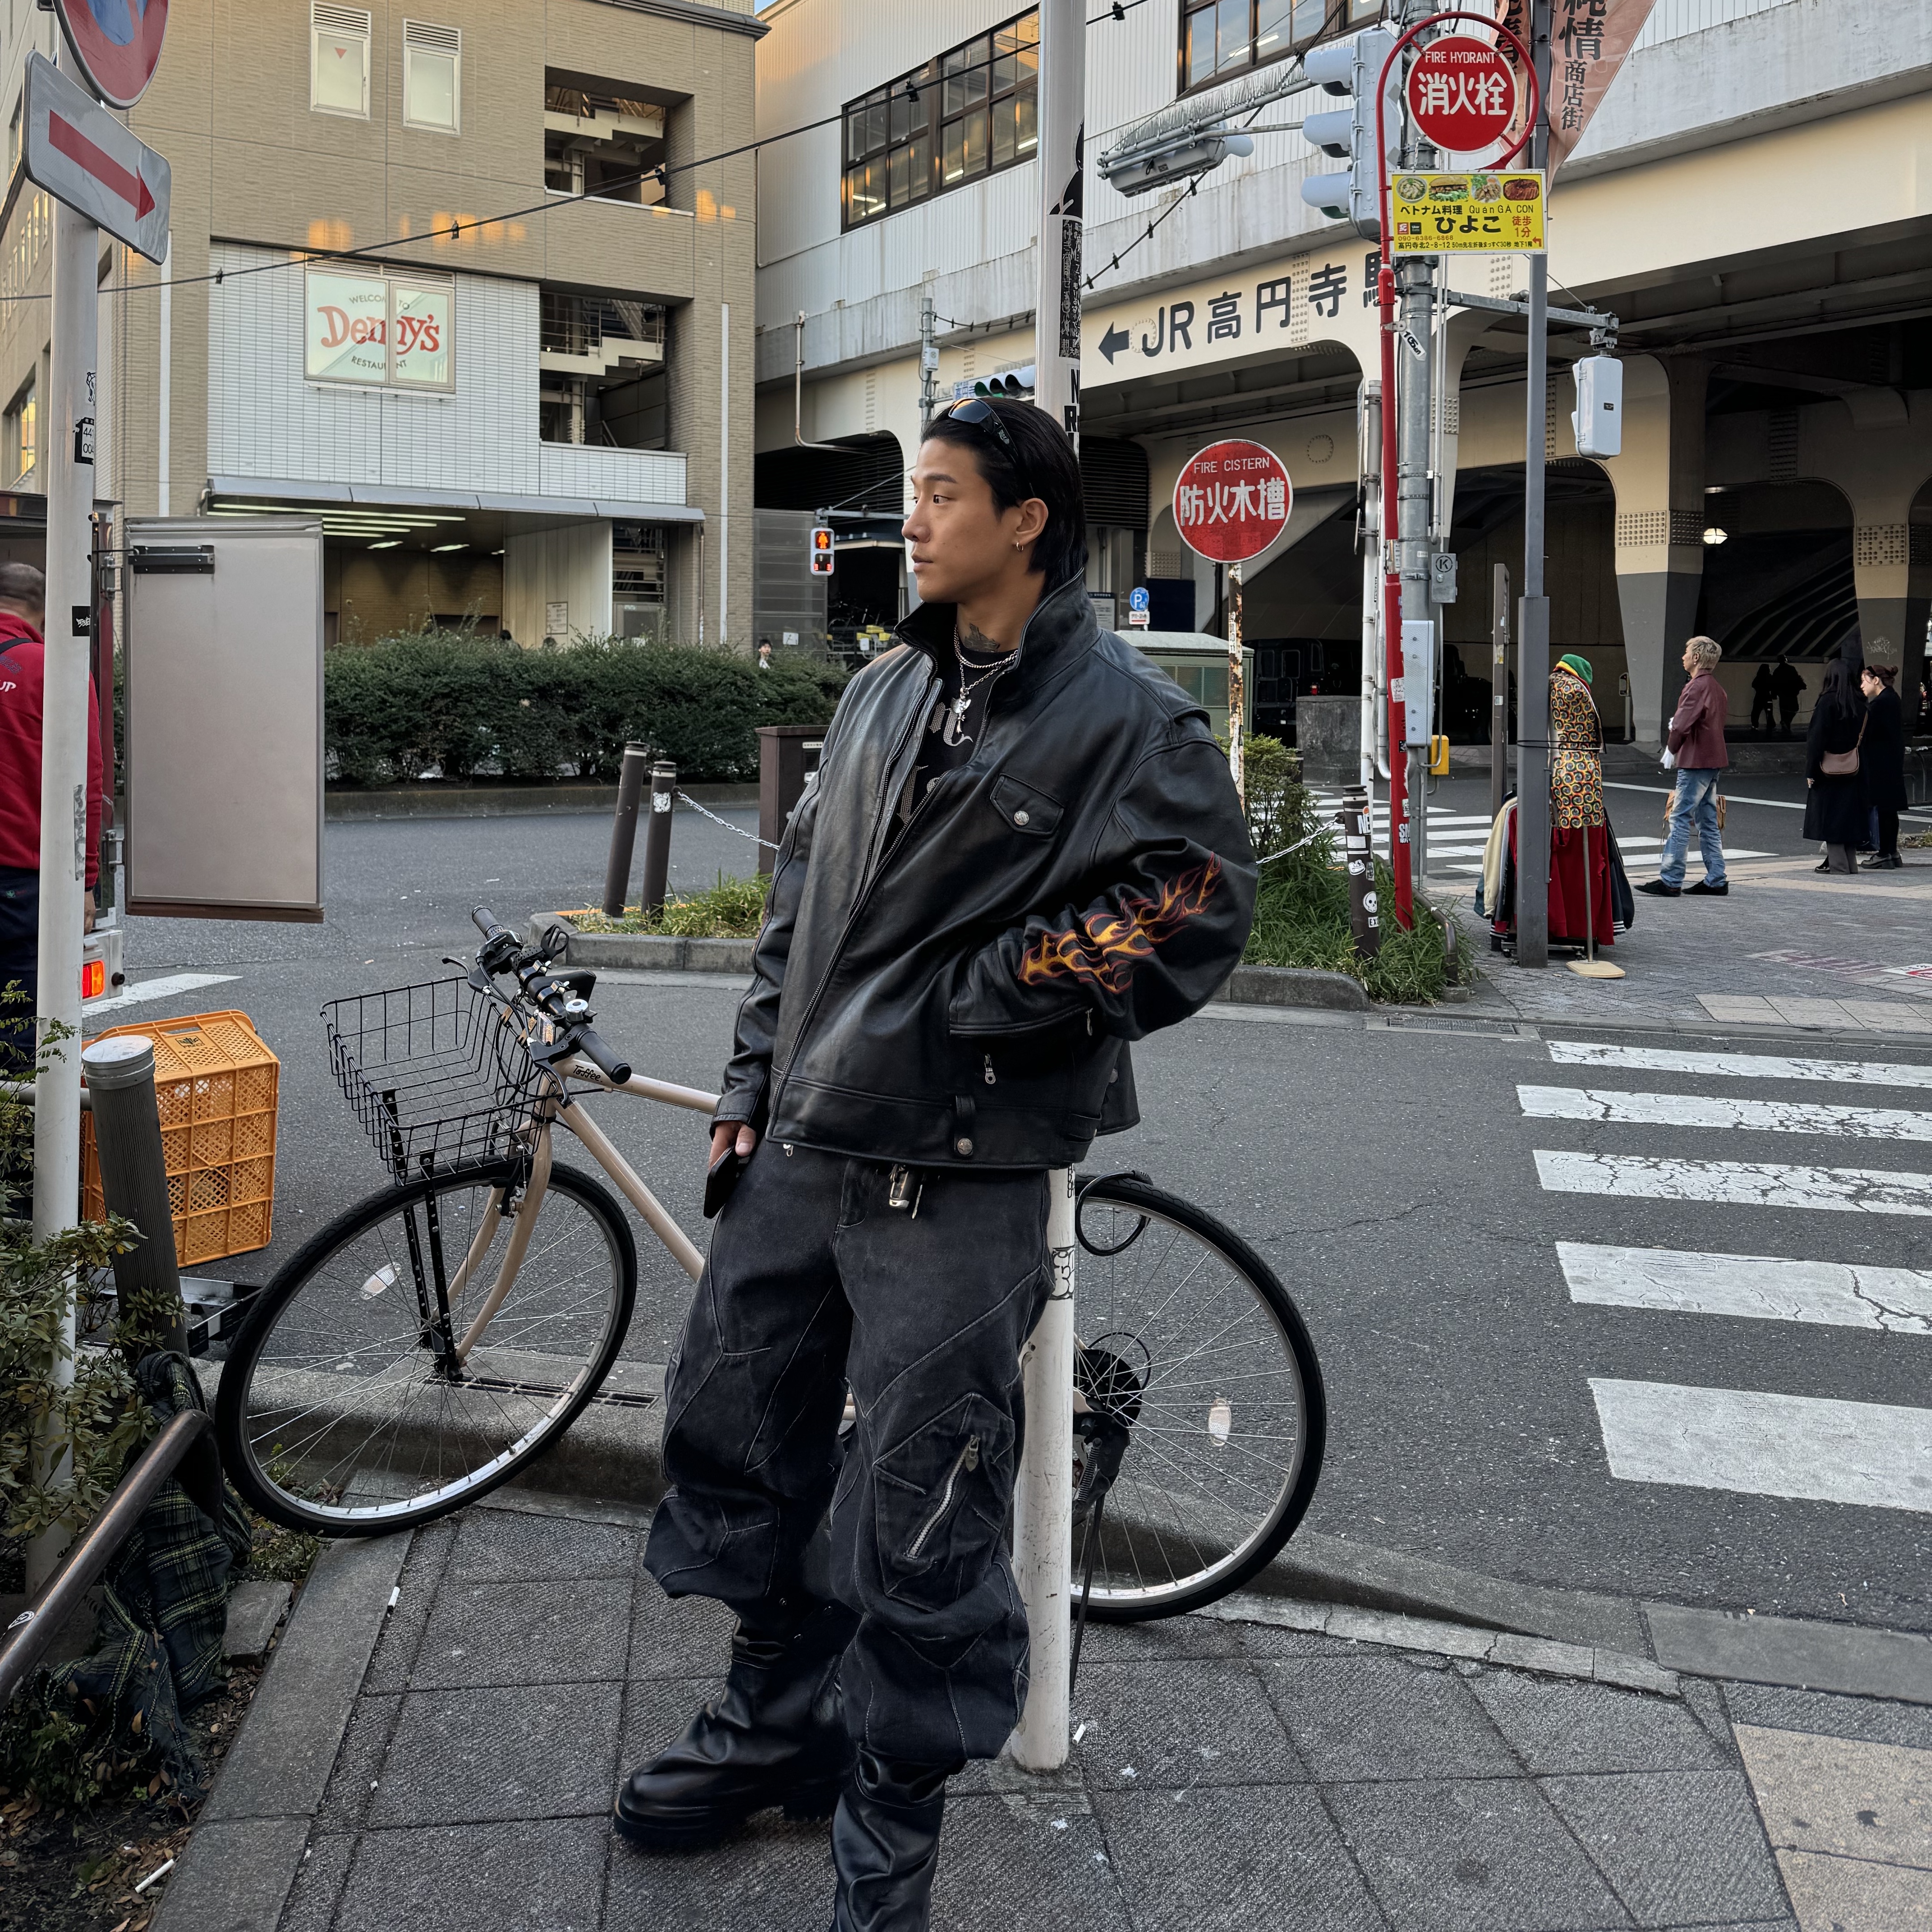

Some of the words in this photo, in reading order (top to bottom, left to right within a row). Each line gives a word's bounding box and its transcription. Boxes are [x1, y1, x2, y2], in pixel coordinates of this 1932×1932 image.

[1425, 51, 1447, 63] FIRE
[1450, 51, 1496, 63] HYDRANT
[1418, 71, 1508, 116] 消火栓
[1400, 205, 1463, 215] ベトナム料理
[1517, 205, 1534, 213] CON
[1434, 215, 1502, 234] ひよこ
[1512, 216, 1532, 226] 徒歩
[399, 299, 410, 310] TO
[317, 306, 439, 355] Denny's
[351, 356, 407, 370] RESTAUNT
[1194, 461, 1218, 474] FIRE
[1224, 457, 1270, 471] CISTERN
[1440, 559, 1448, 569] K
[1134, 594, 1143, 609] P
